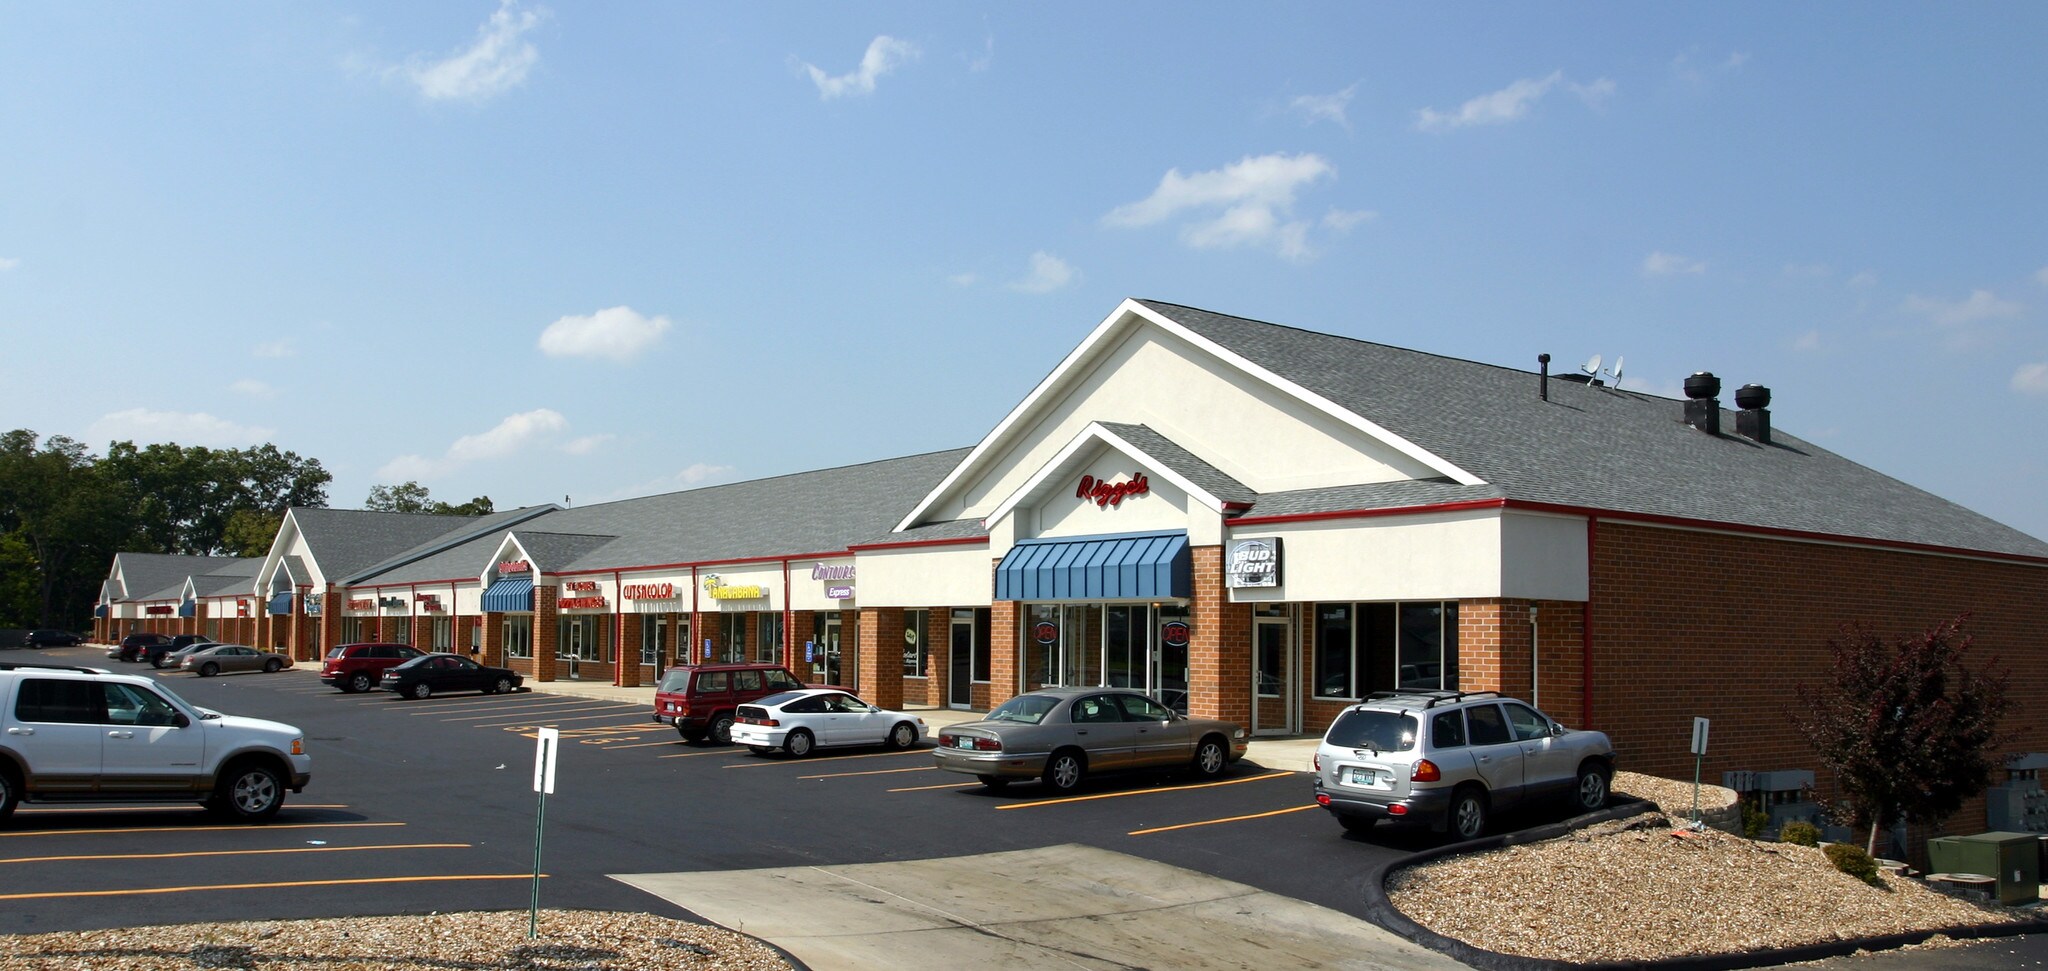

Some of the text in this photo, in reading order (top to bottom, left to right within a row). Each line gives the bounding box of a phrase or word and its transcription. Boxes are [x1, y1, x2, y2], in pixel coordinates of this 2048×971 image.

[1076, 472, 1149, 506] Rizzo's
[1237, 550, 1271, 561] BUD
[1230, 562, 1275, 573] LIGHT
[829, 587, 850, 597] Express
[1033, 627, 1057, 640] OPEN
[1161, 626, 1190, 642] OPEN
